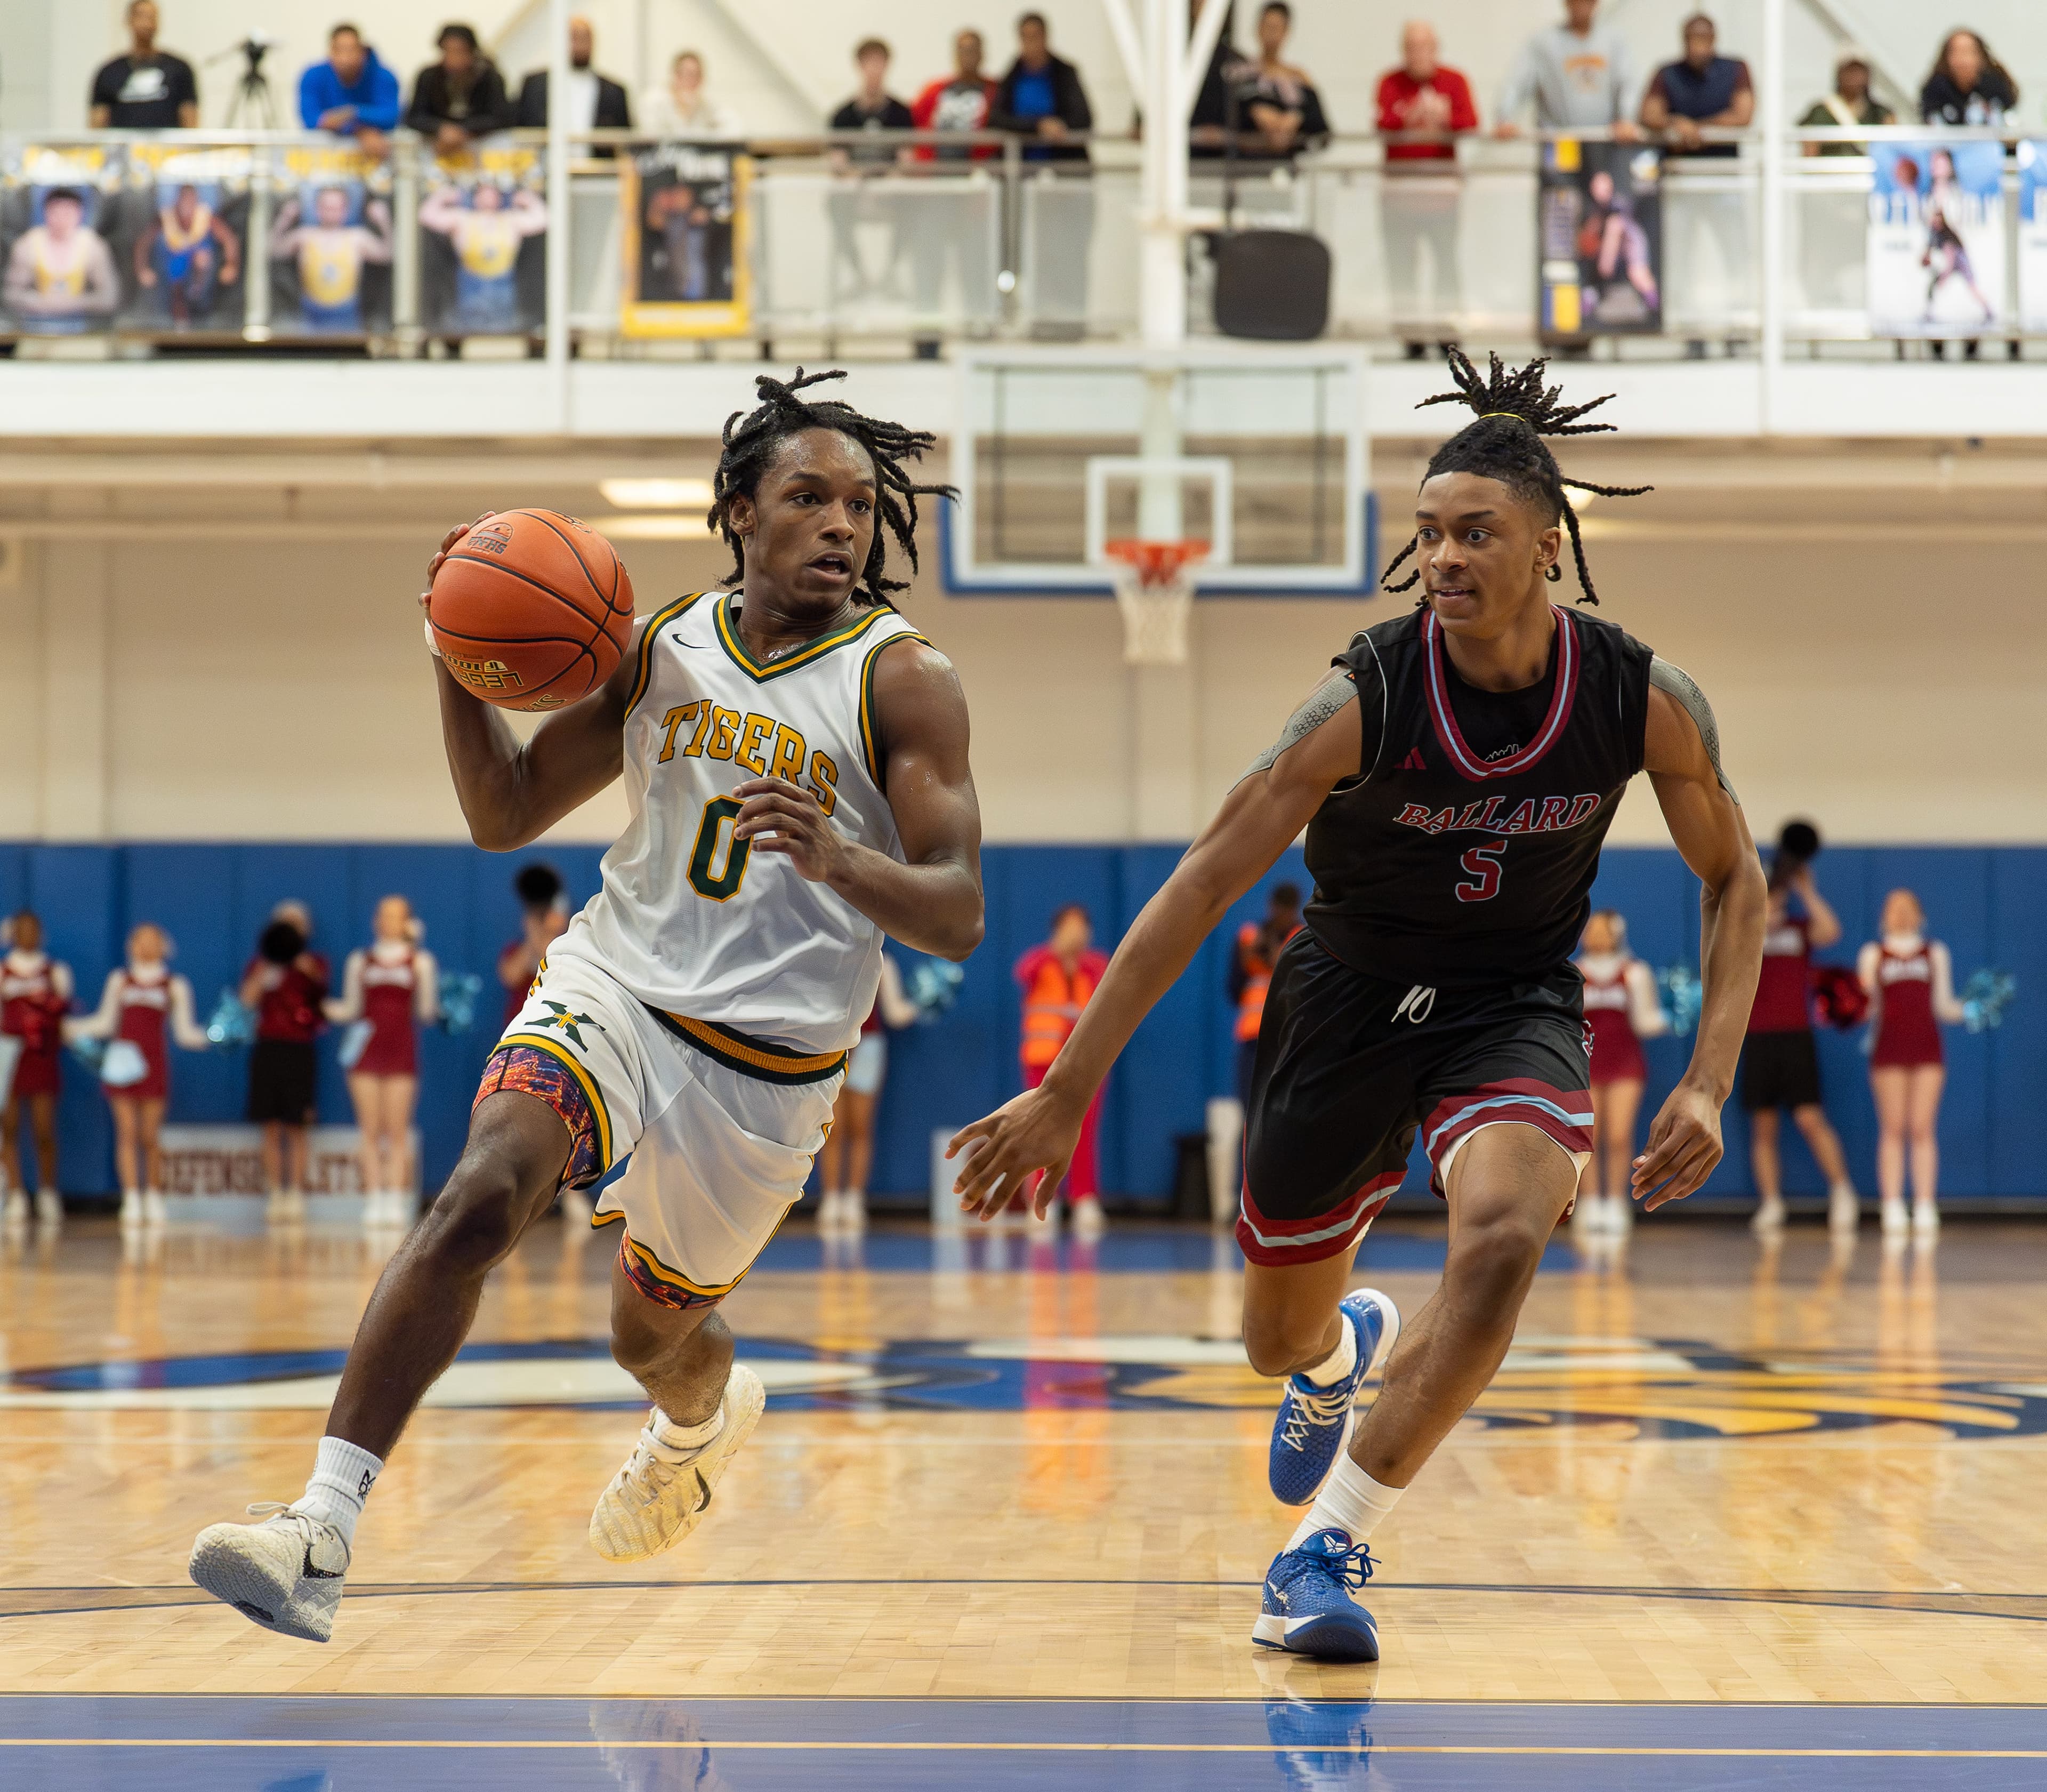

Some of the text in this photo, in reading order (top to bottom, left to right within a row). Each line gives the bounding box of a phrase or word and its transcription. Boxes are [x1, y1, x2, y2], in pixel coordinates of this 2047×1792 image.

[657, 698, 840, 818] TIGERS
[686, 794, 754, 903] 0
[1392, 793, 1601, 834] BALLARD
[1455, 840, 1509, 902] 5
